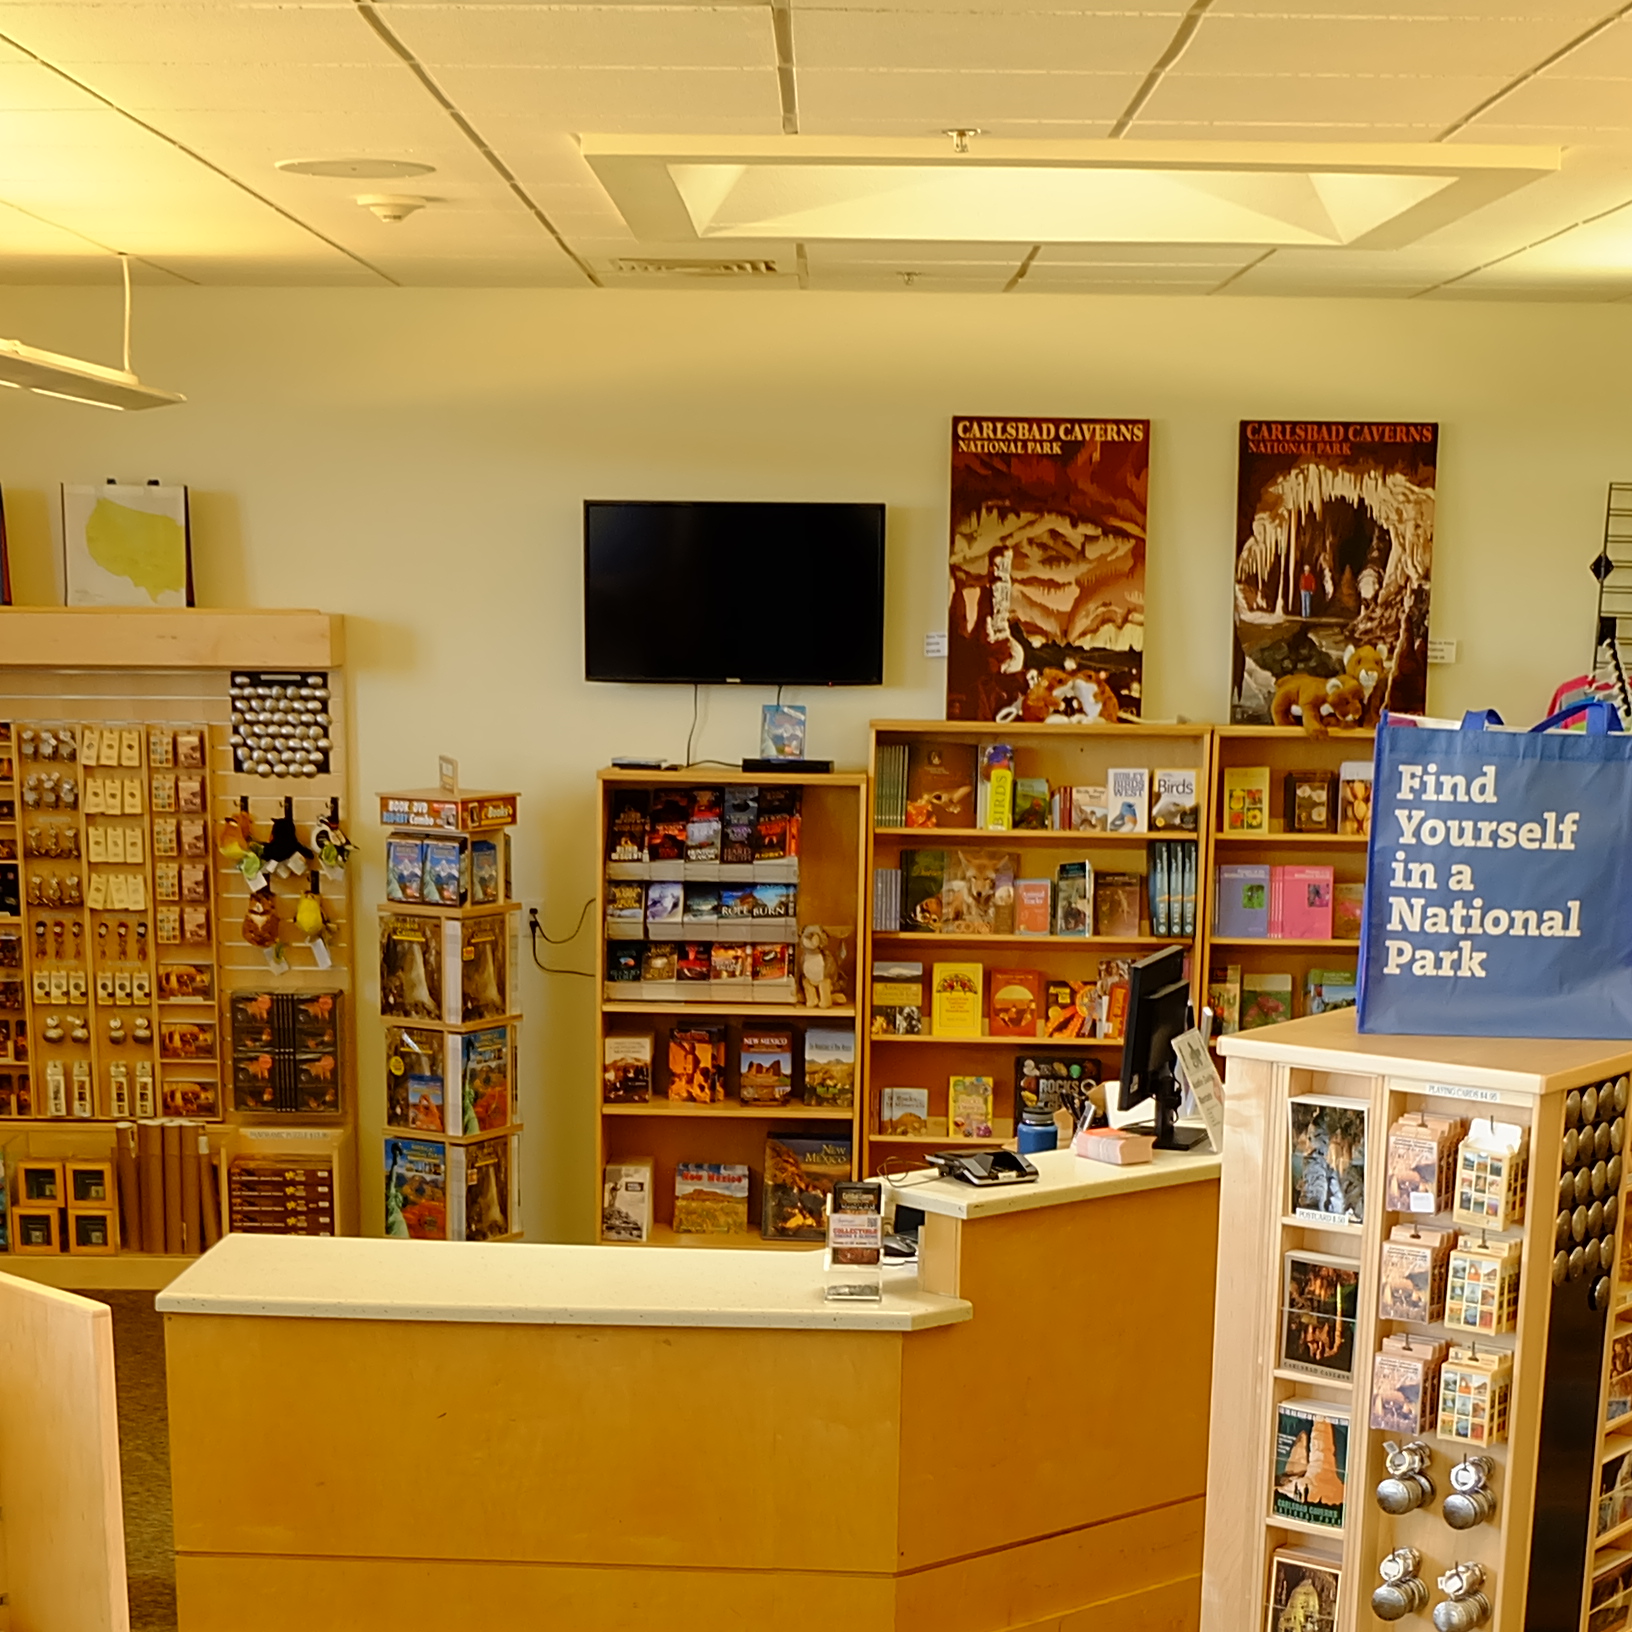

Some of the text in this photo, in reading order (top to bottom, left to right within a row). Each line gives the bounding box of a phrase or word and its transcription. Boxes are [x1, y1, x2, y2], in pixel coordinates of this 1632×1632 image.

[957, 420, 1144, 443] CARLSBAD CAVERNS
[1246, 422, 1433, 444] CARLSBAD CAVERNS
[958, 440, 1062, 455] NATIONAL PARK
[1247, 441, 1352, 456] NATIONAL PARK
[1158, 778, 1194, 795] Birds
[1396, 763, 1498, 803] Find
[993, 774, 1008, 827] BIRDS
[1114, 788, 1144, 797] WEST
[1394, 809, 1580, 850] Yourself
[1390, 851, 1475, 891] in a
[753, 906, 785, 916] BURN
[1386, 896, 1581, 938] National
[1383, 939, 1488, 978] Park
[743, 1037, 788, 1046] NEW MEXICO
[1039, 1078, 1080, 1094] ROCKS
[1428, 1085, 1455, 1097] PLAYING
[1456, 1088, 1478, 1099] CARDS
[822, 1143, 846, 1156] NEW
[805, 1153, 846, 1165] MEXICO
[682, 1171, 743, 1183] New Mexico
